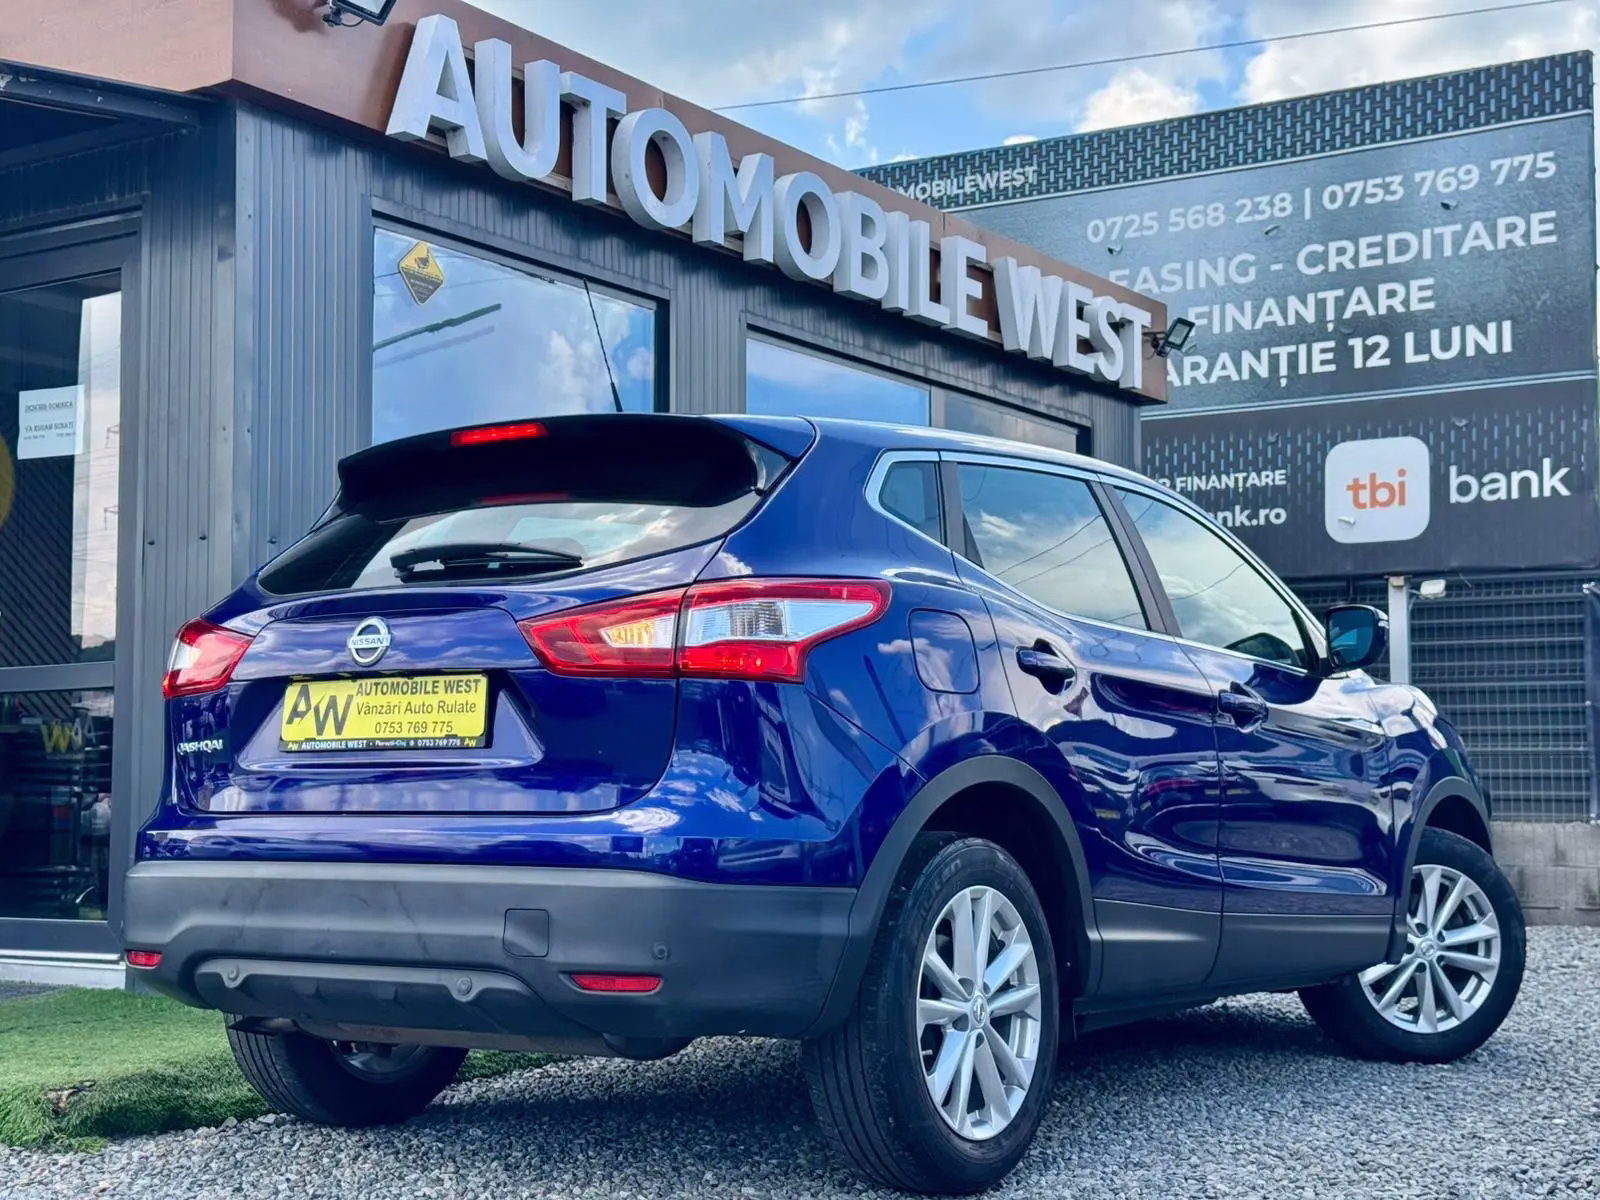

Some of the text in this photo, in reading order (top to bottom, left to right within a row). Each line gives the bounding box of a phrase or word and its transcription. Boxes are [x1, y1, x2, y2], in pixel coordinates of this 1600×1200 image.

[897, 165, 1038, 201] MOBILEWEST
[1086, 212, 1160, 244] 0725
[1168, 203, 1225, 233] 568
[1235, 192, 1294, 224] 238
[1322, 175, 1405, 211] 0753
[1414, 163, 1480, 198] 769
[1490, 150, 1557, 186] 775
[385, 14, 1153, 391] AUTOMOBILE WEST
[1109, 252, 1257, 295] EASING
[1297, 211, 1558, 276] CREDITARE
[1167, 320, 1513, 388] ARANȚIE 12 LUNI
[1345, 457, 1571, 510] tbi bank
[1207, 505, 1287, 528] nk.ro
[351, 637, 385, 646] NISSAN
[356, 678, 481, 697] AUTOMOBILE WEST
[356, 700, 477, 717] Vânzări Auto Rulate
[375, 720, 453, 734] 0753 769 775
[301, 740, 346, 750] AUTOMOBILE
[347, 739, 367, 749] WEST
